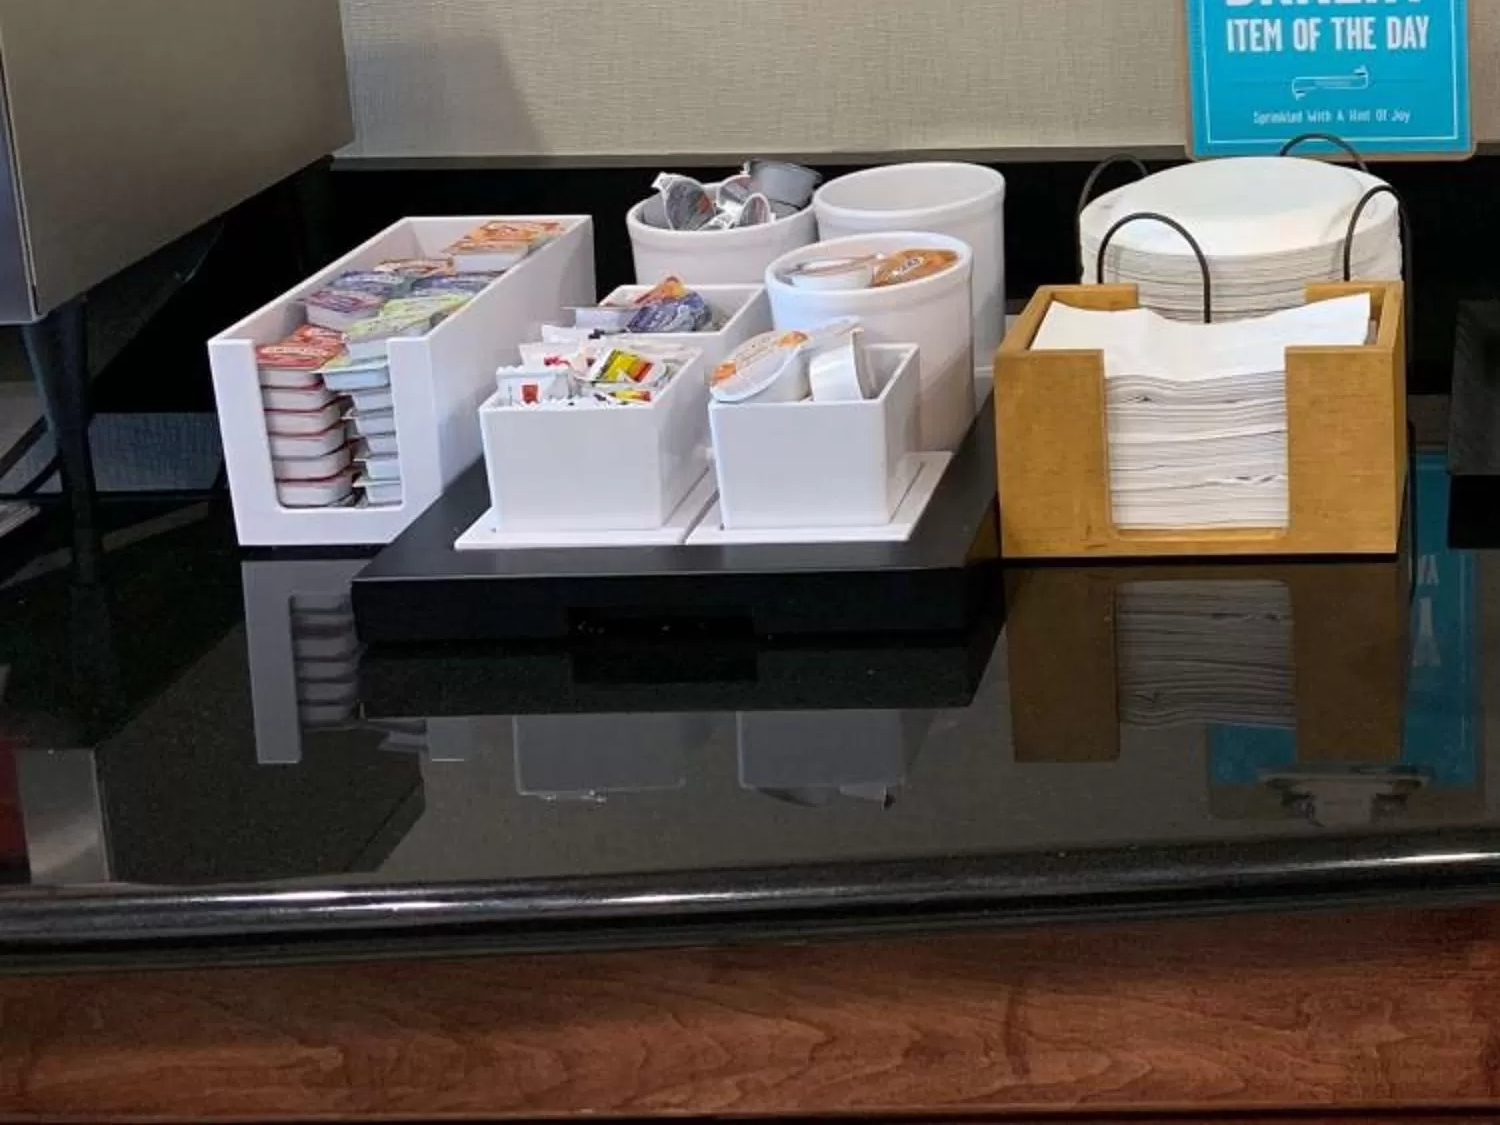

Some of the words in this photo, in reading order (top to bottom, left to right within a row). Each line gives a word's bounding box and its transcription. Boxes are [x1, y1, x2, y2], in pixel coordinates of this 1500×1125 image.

[1227, 18, 1283, 52] ITEM
[1292, 17, 1322, 51] OF
[1330, 16, 1377, 50] THE
[1387, 15, 1429, 50] DAY
